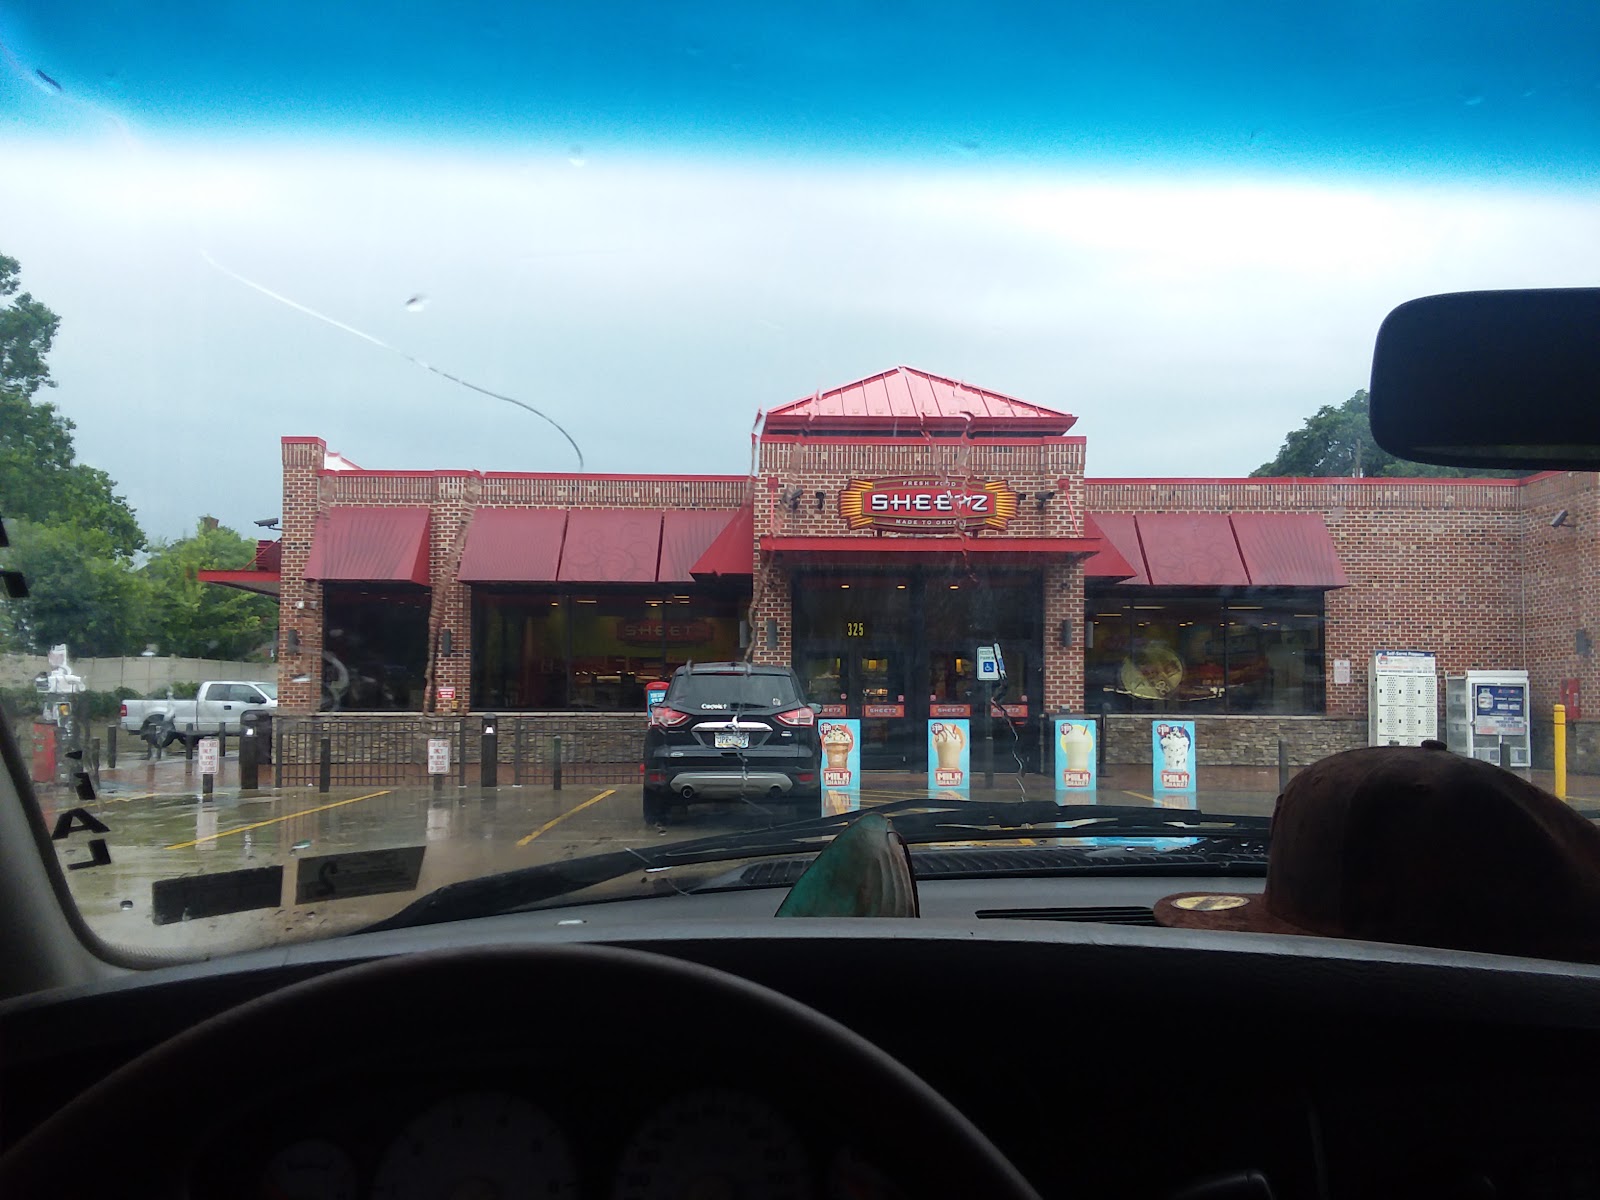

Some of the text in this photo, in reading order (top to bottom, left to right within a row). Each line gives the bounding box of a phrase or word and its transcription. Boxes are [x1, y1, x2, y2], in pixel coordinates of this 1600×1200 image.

[870, 493, 989, 512] SHEEZ
[936, 519, 963, 527] ORDE
[847, 622, 865, 637] 325
[825, 772, 850, 780] MILK
[937, 772, 961, 780] MILK
[1065, 773, 1090, 781] MILK
[1163, 774, 1188, 782] MILK
